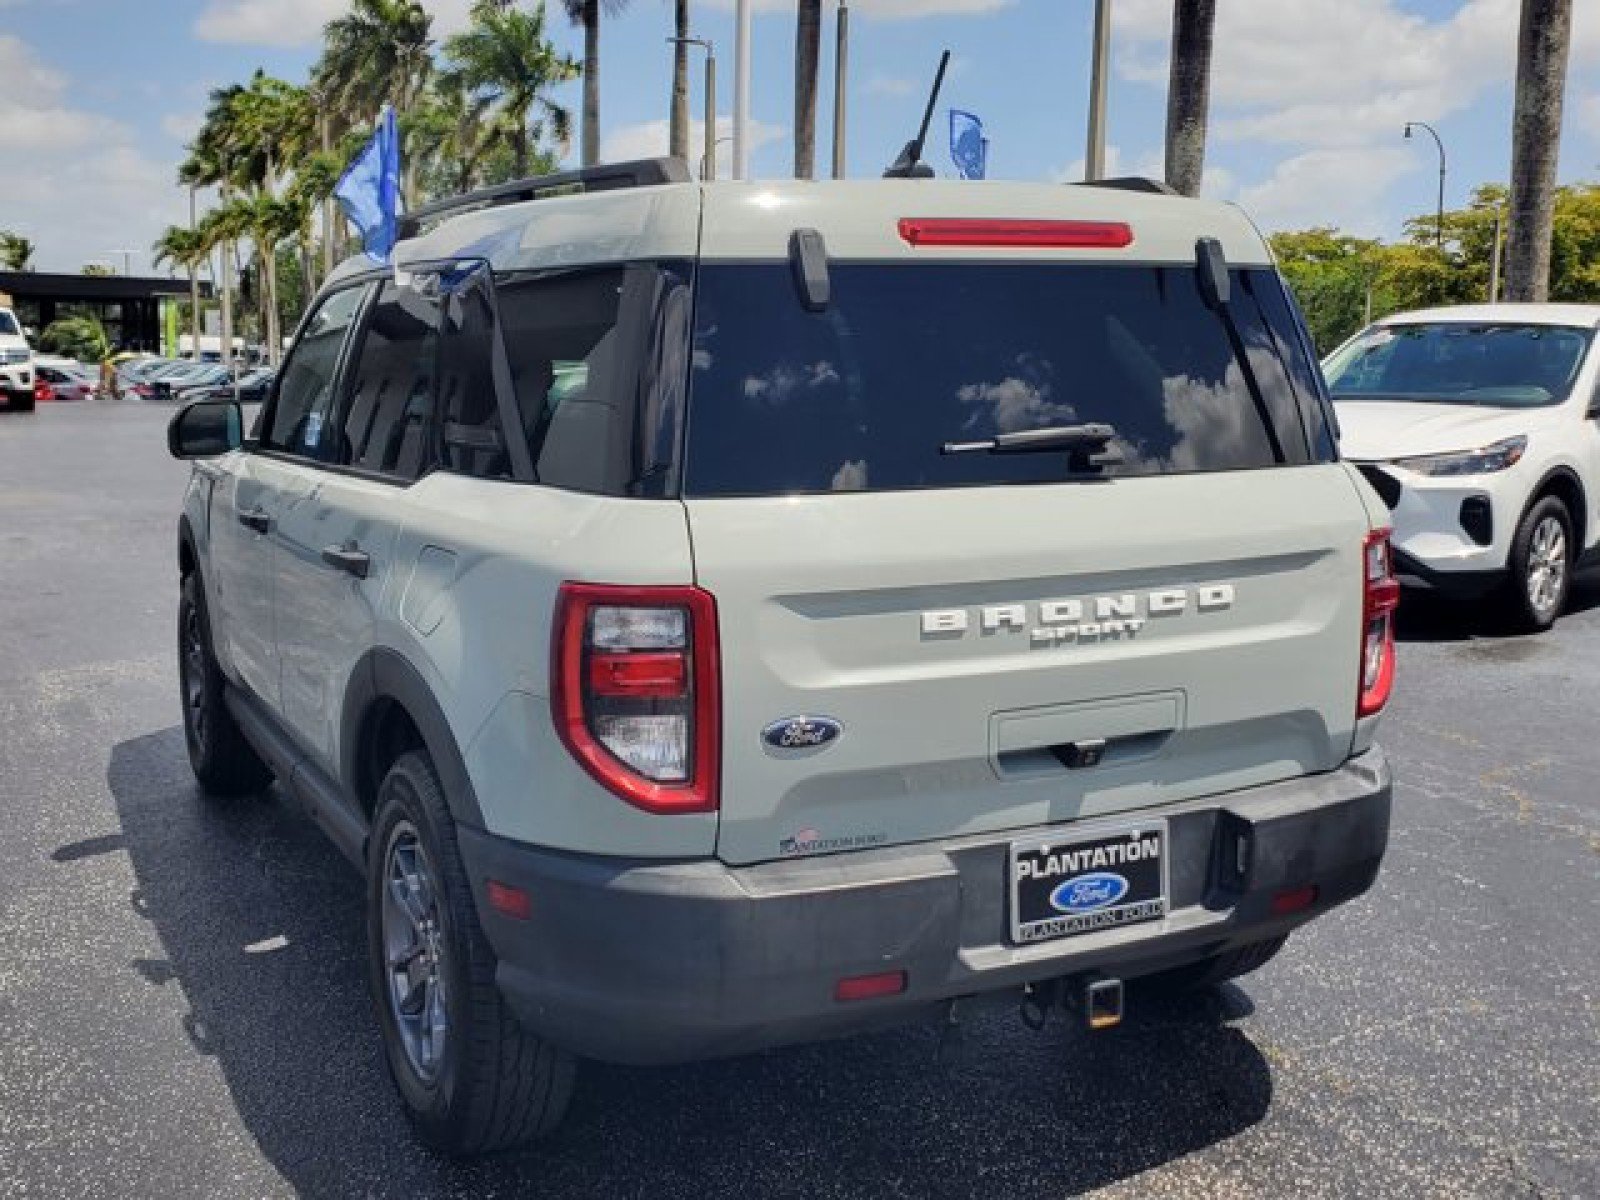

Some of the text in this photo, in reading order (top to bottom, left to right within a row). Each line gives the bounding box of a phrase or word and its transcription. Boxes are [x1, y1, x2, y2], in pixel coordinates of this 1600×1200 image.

[921, 585, 1235, 634] BRONCO
[1031, 619, 1144, 647] SPORT
[1017, 837, 1159, 880] PLANTATION
[1020, 909, 1116, 940] PLANTATION
